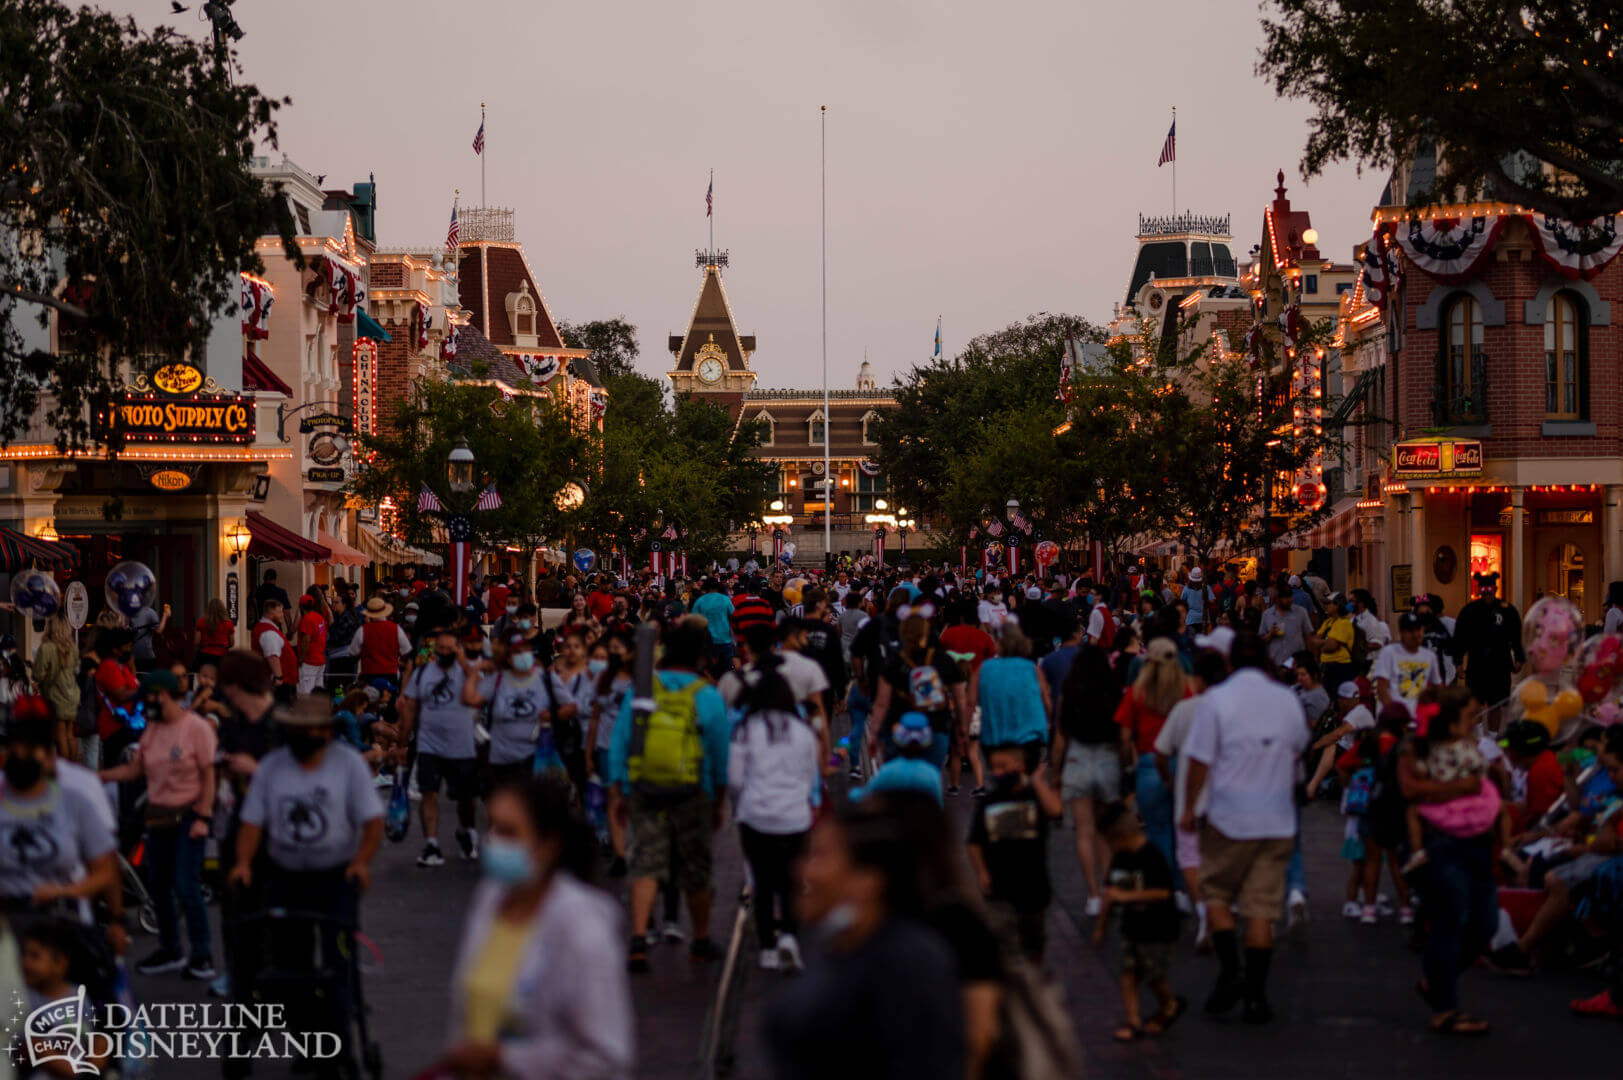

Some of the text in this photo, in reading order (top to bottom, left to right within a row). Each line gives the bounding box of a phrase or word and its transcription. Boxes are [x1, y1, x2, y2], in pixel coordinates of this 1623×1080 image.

[360, 354, 369, 394] CHINA
[164, 403, 225, 431] SUPPLY
[158, 472, 184, 487] Nikon
